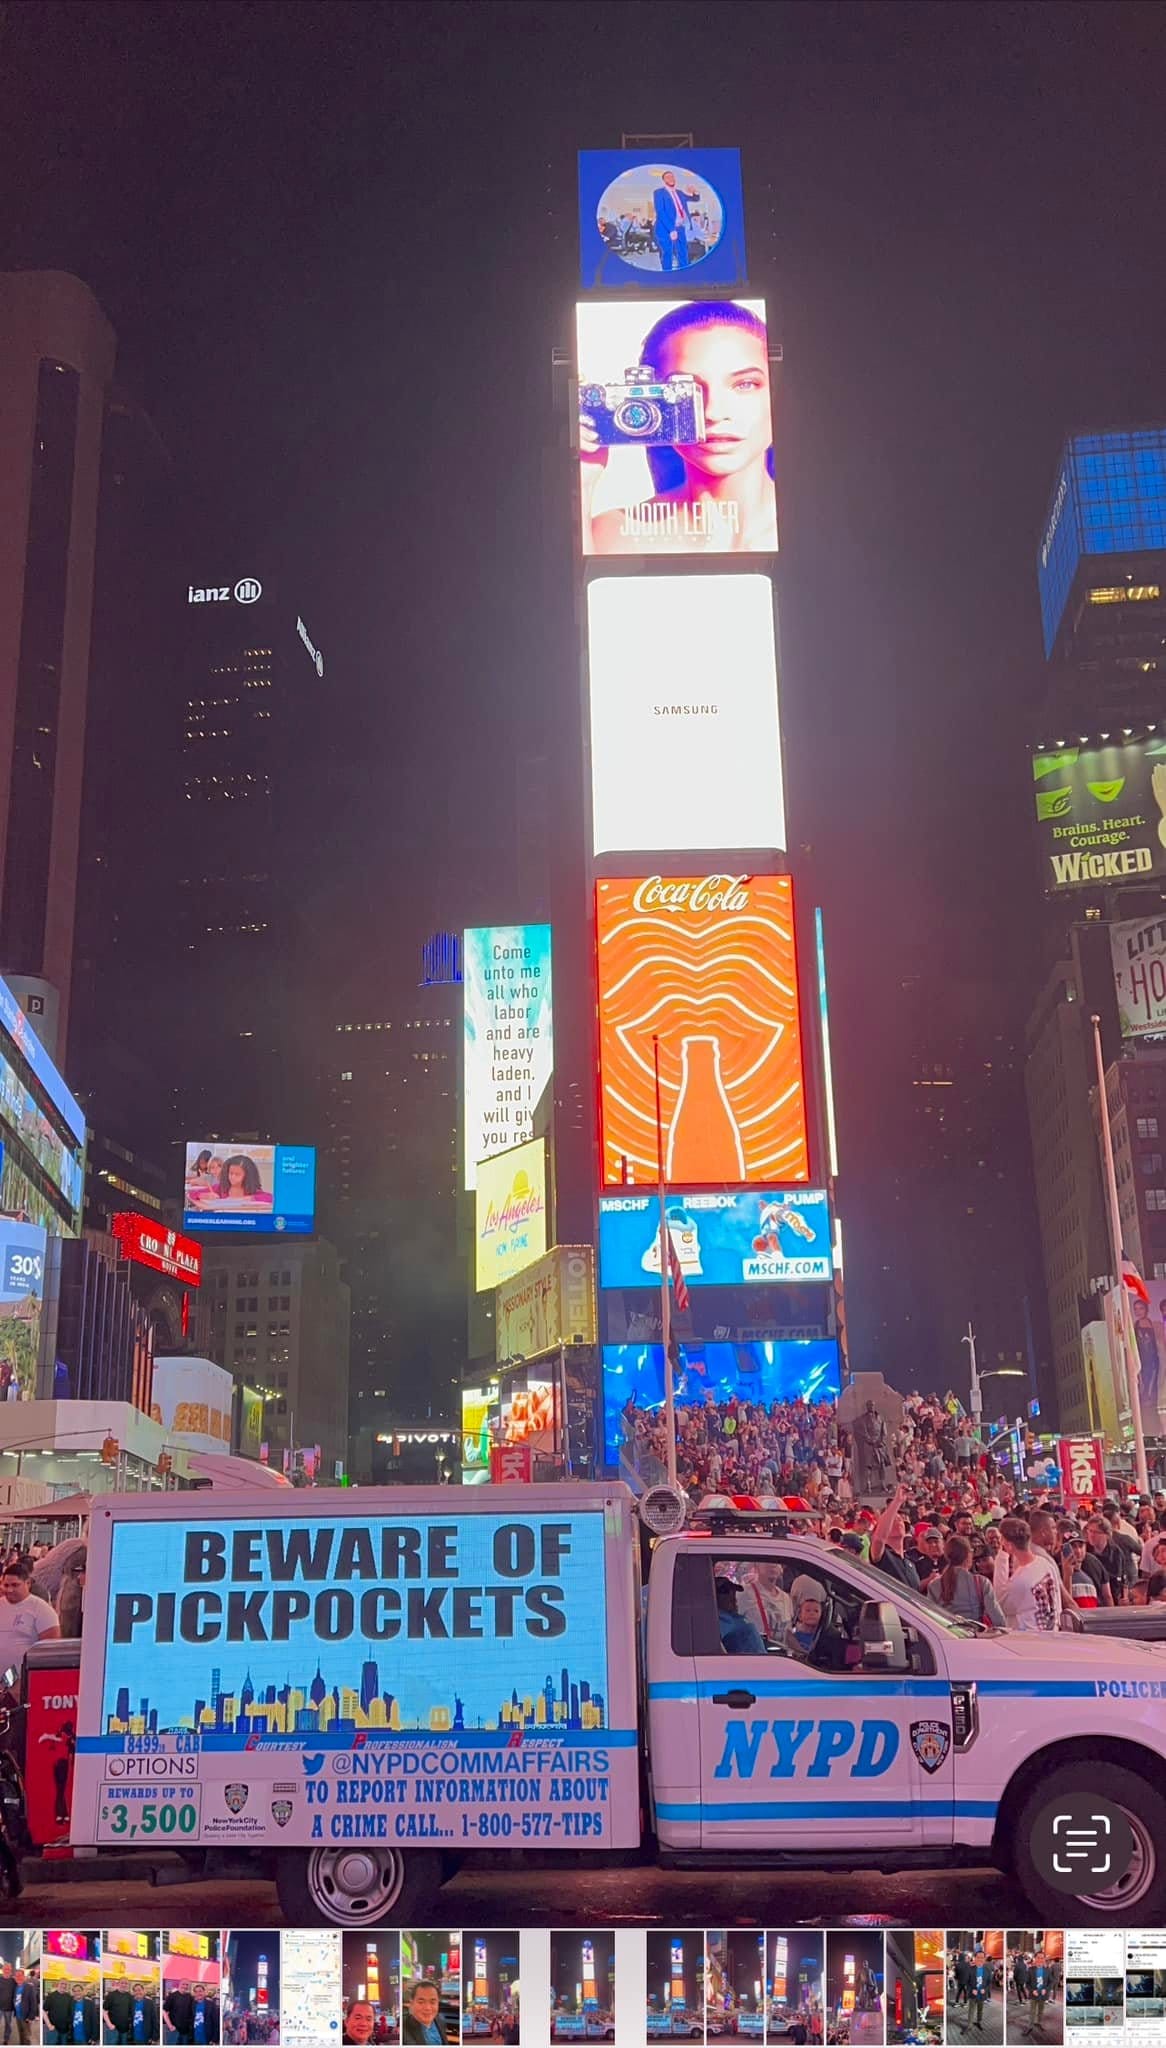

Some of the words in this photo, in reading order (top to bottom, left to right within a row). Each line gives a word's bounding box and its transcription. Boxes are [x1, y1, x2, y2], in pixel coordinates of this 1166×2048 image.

[620, 502, 678, 536] JUDITH
[653, 705, 718, 715] SAMSUNG
[1052, 824, 1101, 839] Brains.
[1103, 815, 1146, 831] Heart.
[1070, 831, 1131, 849] Courage.
[633, 874, 748, 912] Coca-Cola
[493, 945, 531, 960] Come
[484, 966, 514, 981] unto
[520, 966, 541, 979] me
[487, 986, 504, 1001] all
[510, 984, 538, 999] who
[494, 1005, 531, 1020] labor
[486, 1025, 511, 1041] and
[517, 1025, 540, 1039] are
[493, 1047, 533, 1064] heavy
[492, 1066, 535, 1081] laden.
[496, 1086, 521, 1102] and
[527, 1086, 531, 1100] I
[484, 1108, 510, 1123] will
[515, 1107, 534, 1126] giv
[482, 1132, 507, 1149] you
[513, 1130, 534, 1145] res
[602, 1198, 650, 1211] MSCHF
[683, 1196, 737, 1208] REEBOK
[784, 1192, 824, 1205] PUMP
[481, 1200, 499, 1238] Los
[498, 1187, 544, 1234] Angeles
[140, 1233, 174, 1260] CRON
[748, 1261, 824, 1275] MSCHF.COM
[1069, 1442, 1097, 1495] tkts
[184, 1525, 459, 1585] BEWARE
[492, 1523, 572, 1579] OF
[113, 1585, 567, 1645] PICKPOCKETS
[1097, 1680, 1161, 1698] POLICE
[127, 1735, 159, 1753] 8499
[176, 1735, 200, 1753] CAB
[245, 1734, 306, 1752] COURTESY
[351, 1733, 459, 1751] PROFESSIONALISM
[506, 1731, 565, 1748] RESPECT
[713, 1720, 900, 1780] NYPD
[109, 1757, 195, 1776] OPTIONS
[332, 1750, 609, 1775] @NYPDCOMMAFFAIRS
[108, 1788, 157, 1799] REWARDS
[162, 1788, 176, 1798] UP
[179, 1788, 194, 1798] TO
[305, 1781, 329, 1803] TO
[337, 1780, 408, 1803] REPORT
[415, 1779, 541, 1802] INFORMATION
[549, 1778, 609, 1801] ABOUT
[101, 1804, 197, 1838] $3,500
[311, 1815, 323, 1838] A
[331, 1814, 388, 1837] CRIME
[395, 1813, 454, 1837] CALL...
[462, 1812, 602, 1836] 1-800-577-TIPS
